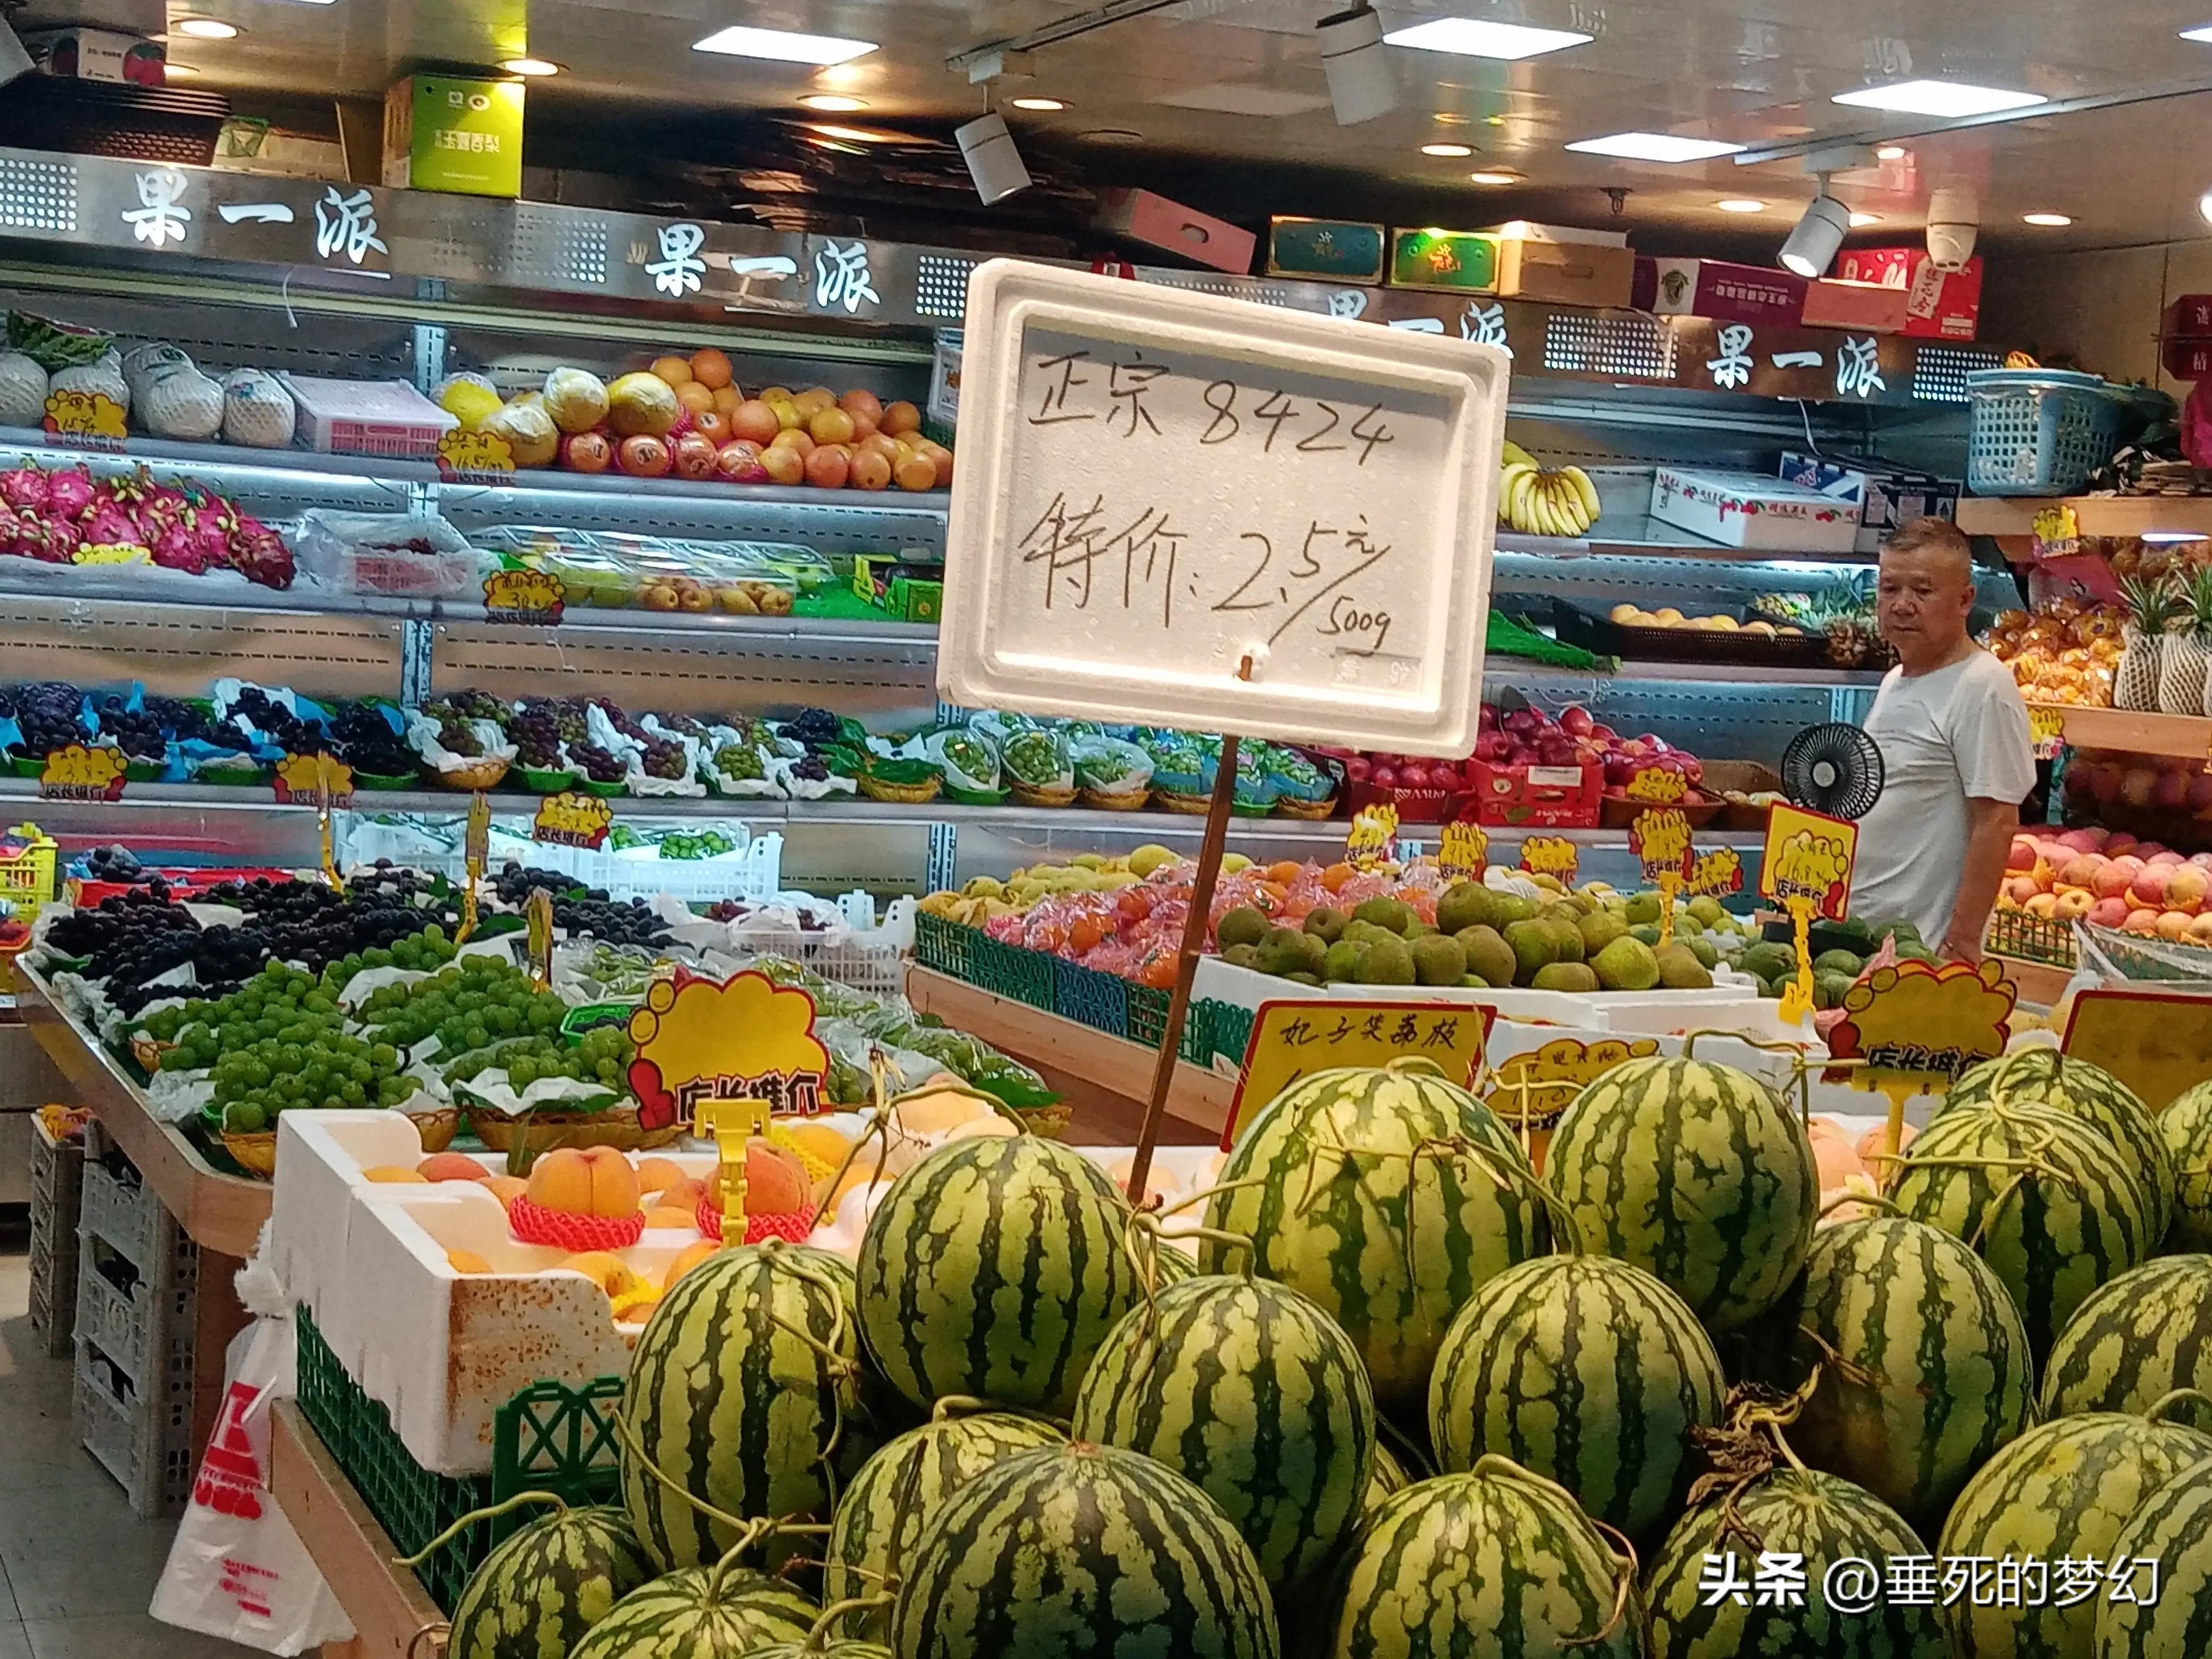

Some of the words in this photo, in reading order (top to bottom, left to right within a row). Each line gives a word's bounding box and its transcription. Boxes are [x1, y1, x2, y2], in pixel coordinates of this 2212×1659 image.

[121, 168, 389, 264] 果一派
[644, 223, 881, 313] 果一派
[1706, 325, 1886, 398] 果一派
[1028, 351, 1173, 438] 正宗
[1200, 378, 1395, 466] 8424
